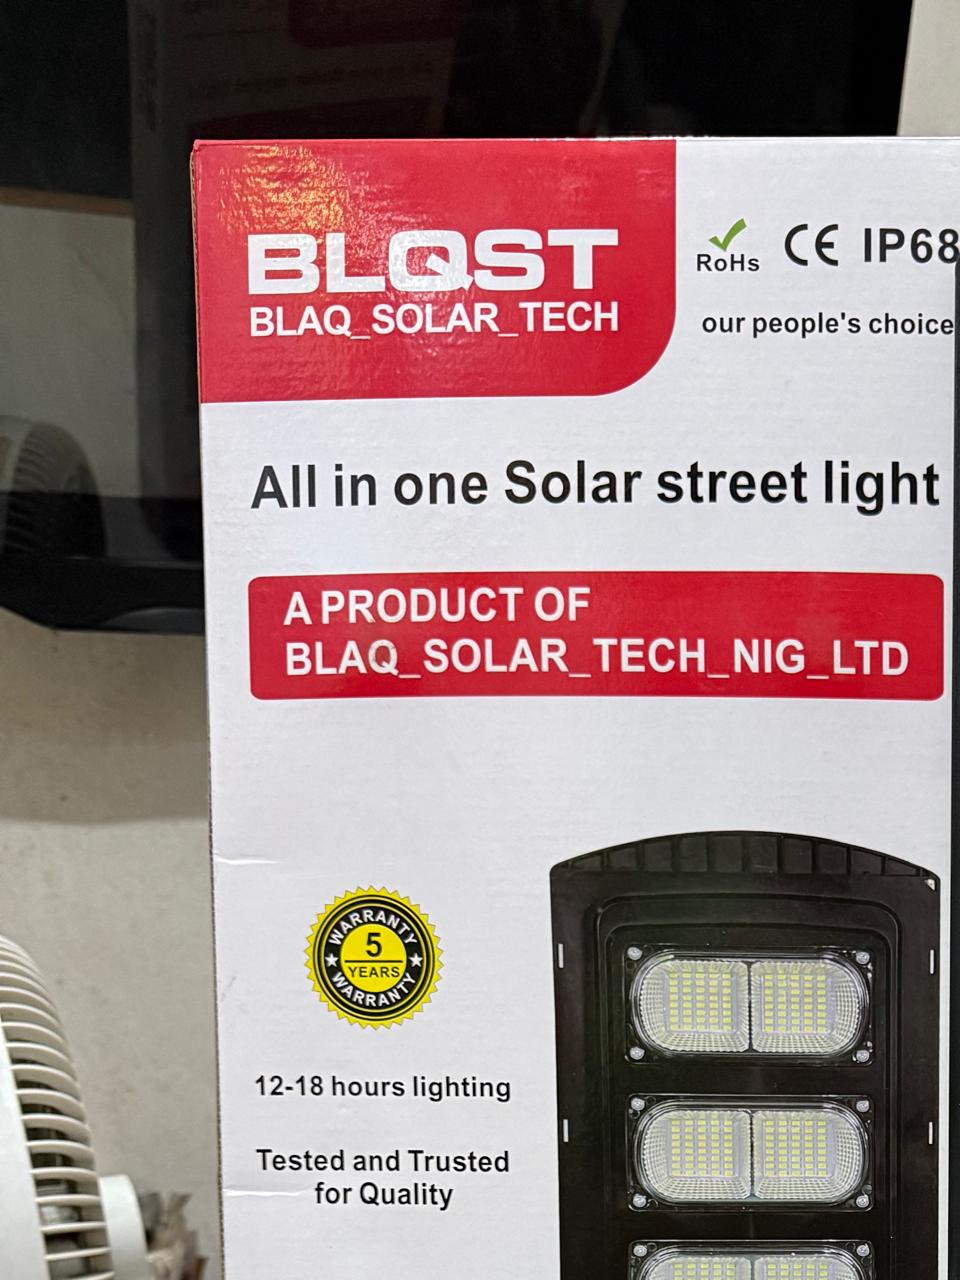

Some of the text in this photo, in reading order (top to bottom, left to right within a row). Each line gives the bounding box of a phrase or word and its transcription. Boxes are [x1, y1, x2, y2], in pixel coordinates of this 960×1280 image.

[247, 228, 619, 295] BLQST
[696, 224, 960, 272] RoHs CE IP68
[249, 301, 619, 340] BLAQ_SOLAR_TECH
[701, 311, 955, 339] our people's choice
[251, 459, 940, 515] All in one Solar street light
[284, 586, 589, 625] A PRODUCT OF
[285, 638, 910, 681] BLAQ_SOLAR_TECH_NIG_LTD
[329, 908, 416, 947] WARRANTY
[366, 932, 382, 957] 5
[331, 972, 414, 1007] WARRANTY
[348, 965, 400, 979] YEARS
[255, 1076, 511, 1101] 12-18 hours lighting
[256, 1149, 509, 1171] Tested and Trusted
[315, 1182, 453, 1210] for Quality
